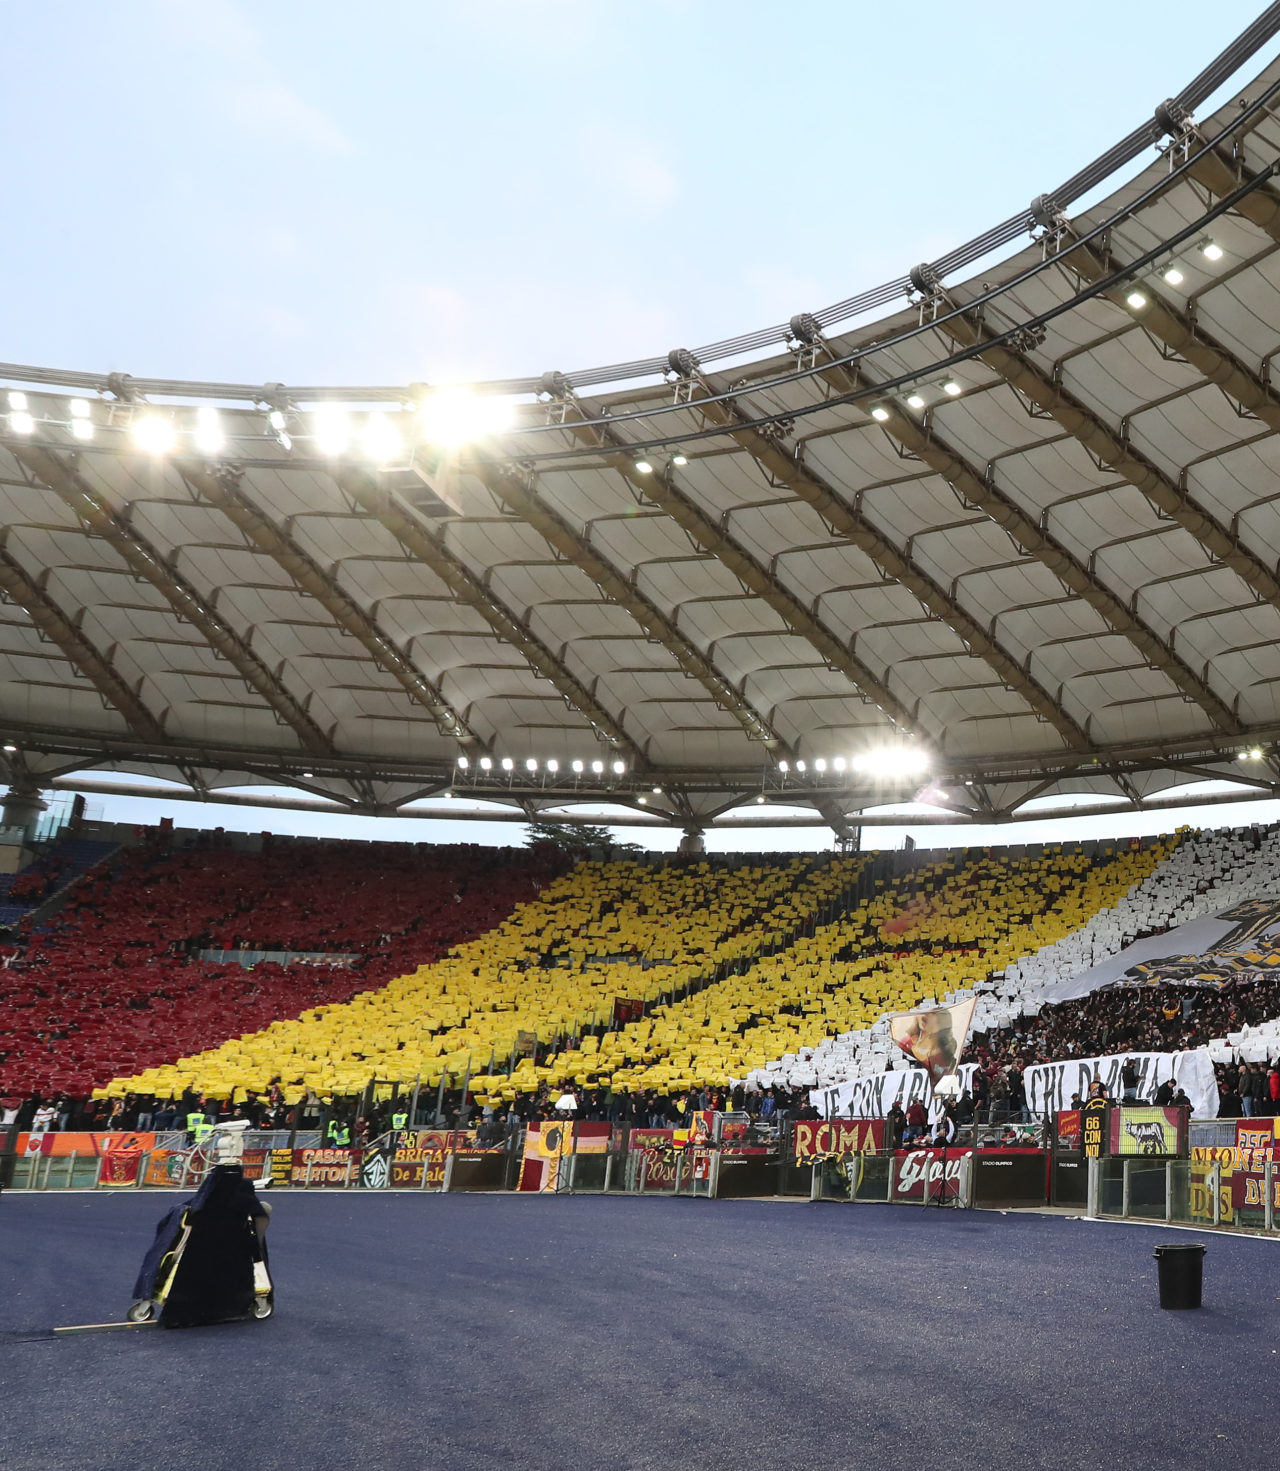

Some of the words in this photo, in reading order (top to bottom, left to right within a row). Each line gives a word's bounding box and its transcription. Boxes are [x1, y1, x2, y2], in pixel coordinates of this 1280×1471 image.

[1031, 1064, 1065, 1122] CHI
[1084, 1129, 1101, 1144] CON
[1085, 1116, 1100, 1130] 66
[795, 1122, 877, 1158] ROMA
[1085, 1144, 1100, 1158] NOI
[1233, 1147, 1278, 1175] NEL
[1244, 1177, 1267, 1206] DI
